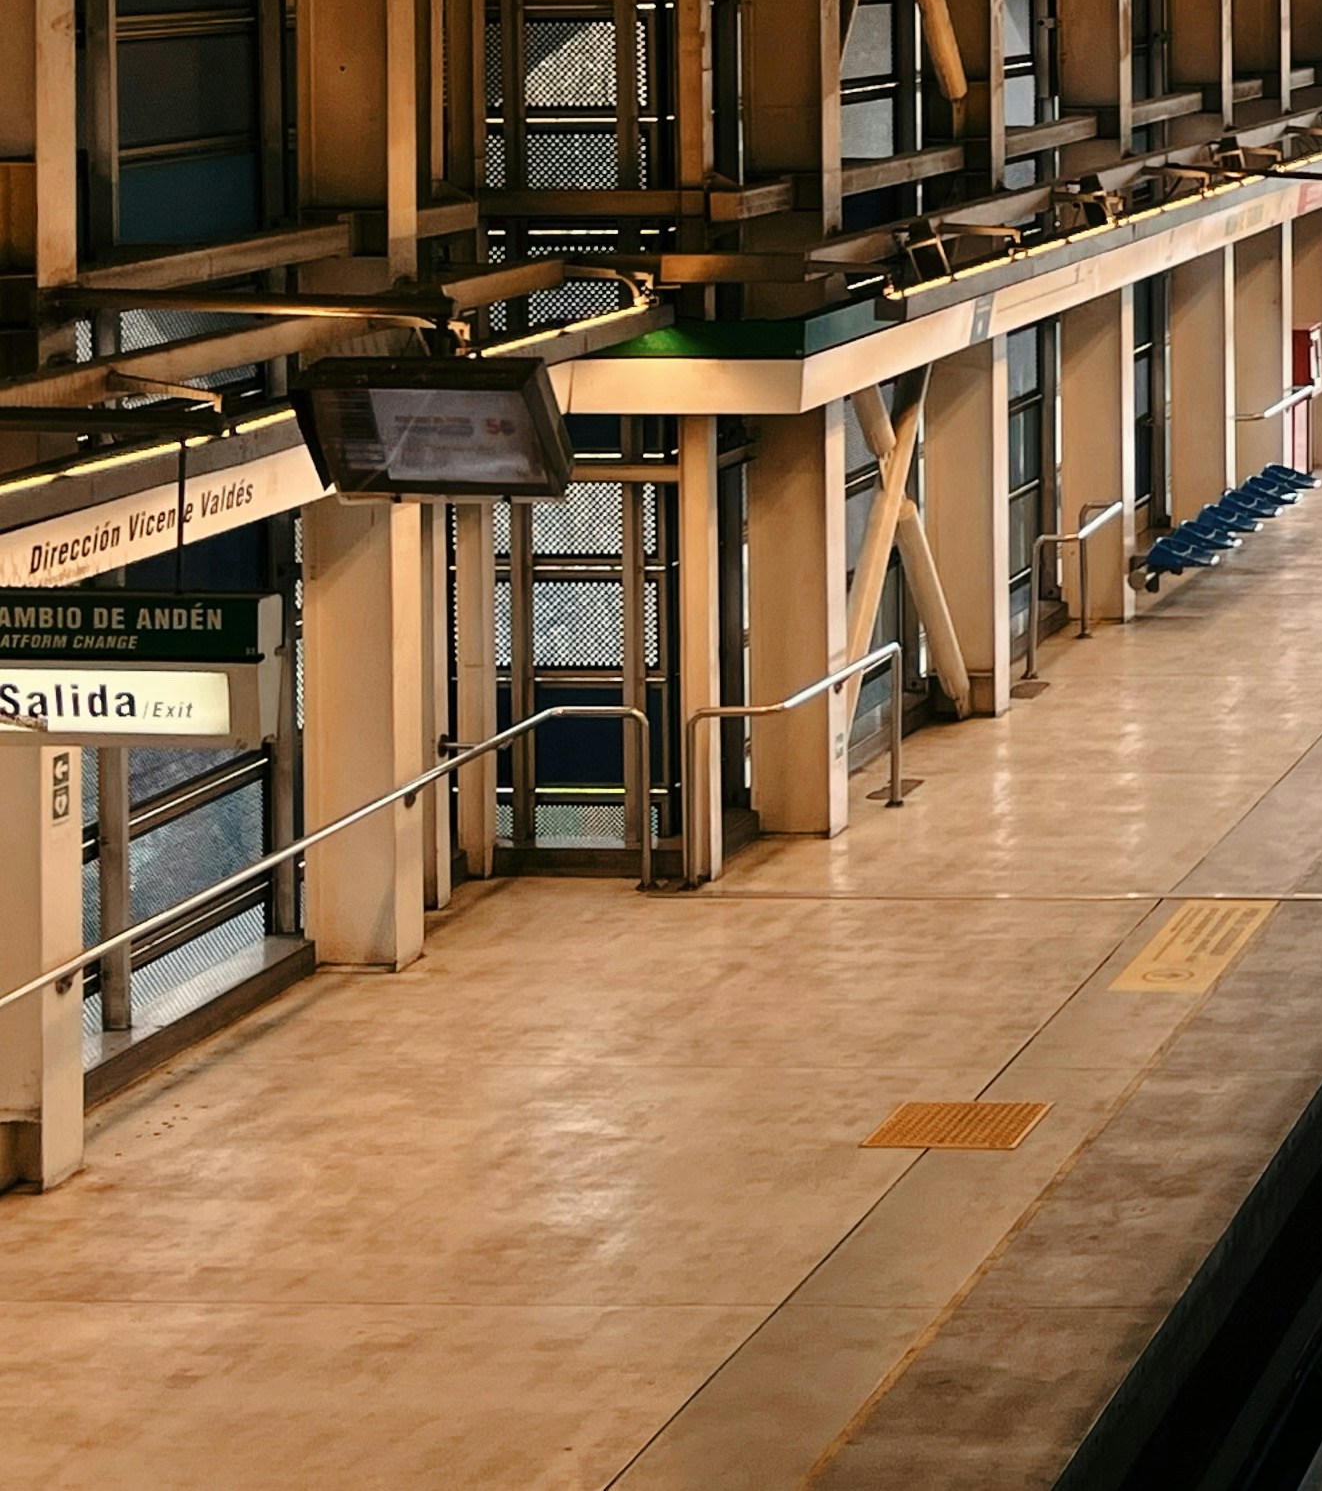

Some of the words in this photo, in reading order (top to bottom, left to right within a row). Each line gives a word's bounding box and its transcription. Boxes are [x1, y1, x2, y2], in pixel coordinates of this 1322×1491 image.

[29, 521, 121, 575] Dirección
[128, 501, 194, 542] Vicene
[200, 479, 255, 519] Valdés
[93, 607, 126, 629] DE
[136, 603, 223, 630] ANDÉN
[73, 635, 139, 650] CHANGE
[0, 683, 137, 718] Salida
